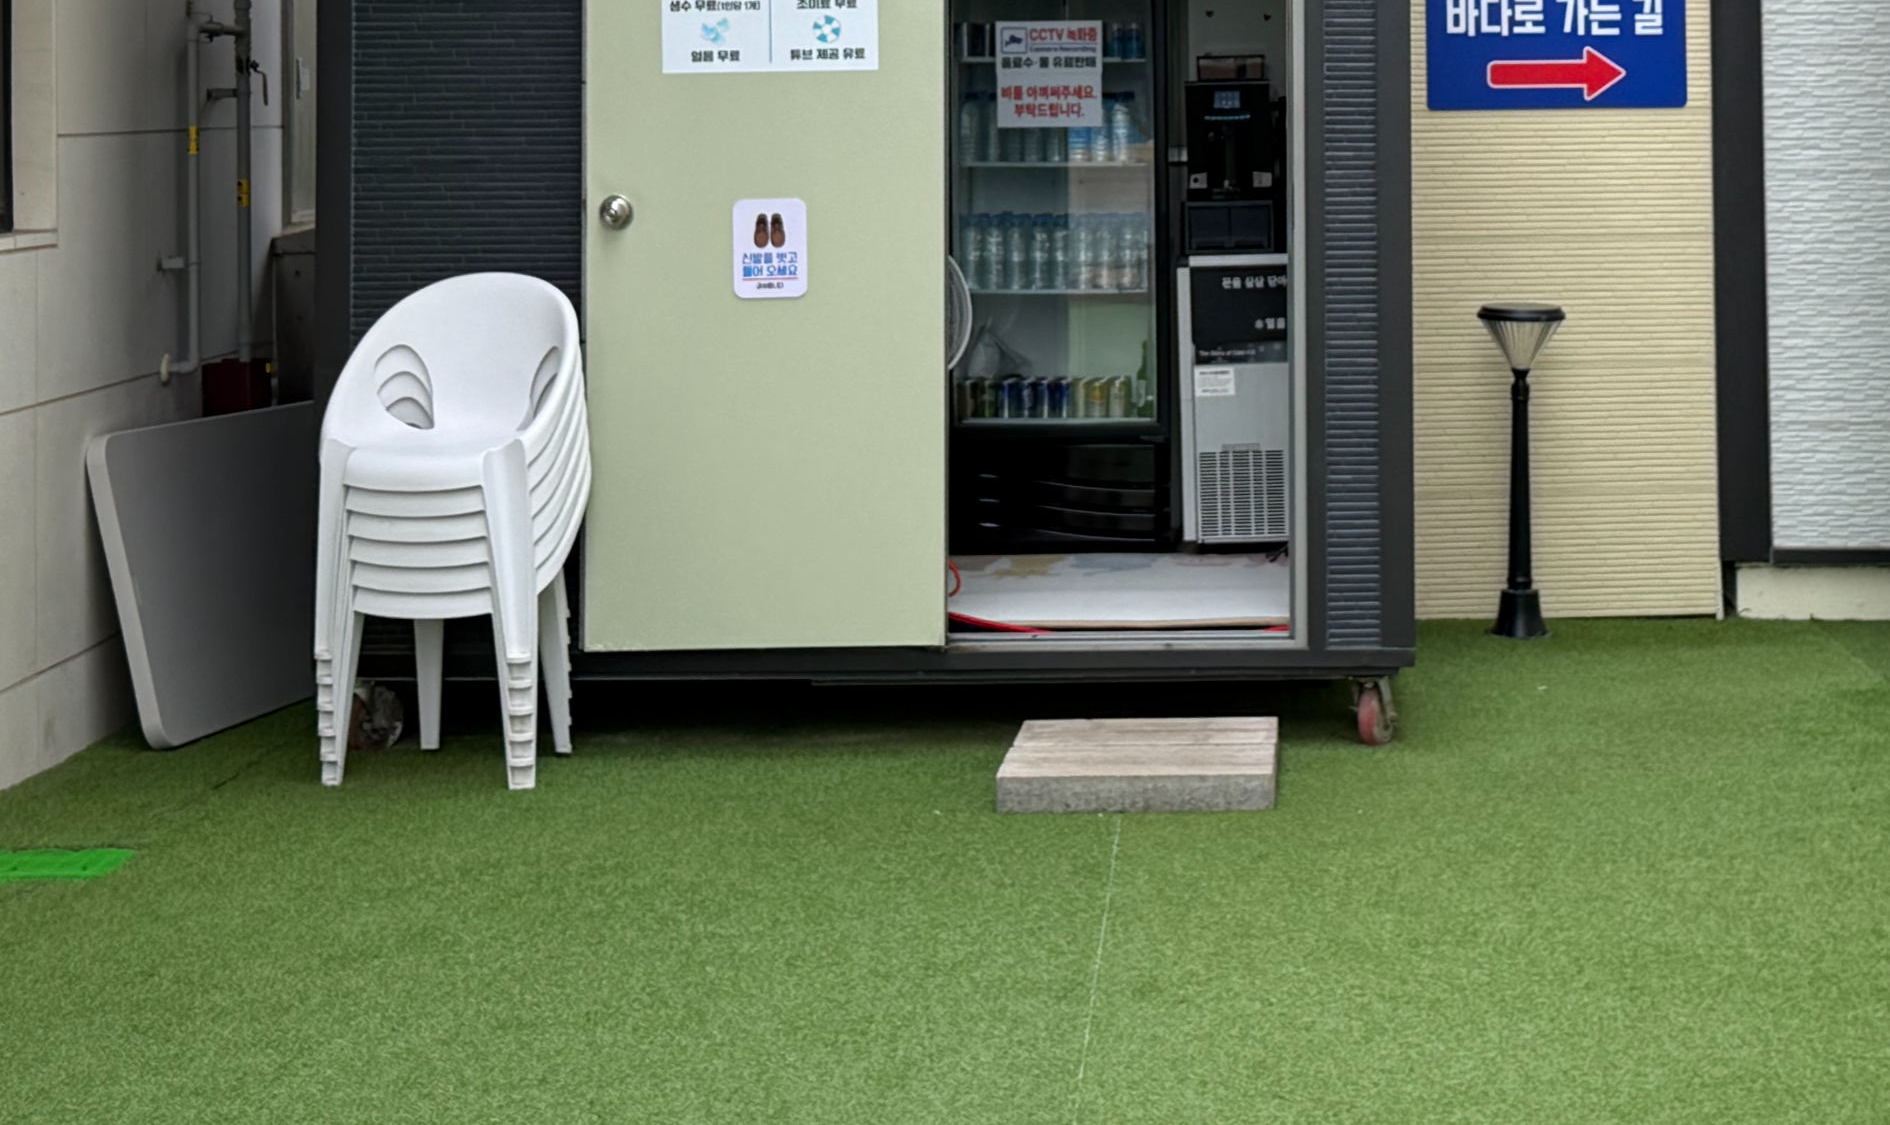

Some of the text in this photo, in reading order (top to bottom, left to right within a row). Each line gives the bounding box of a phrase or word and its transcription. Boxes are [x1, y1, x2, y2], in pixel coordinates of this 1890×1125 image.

[669, 0, 692, 12] 생수
[1029, 28, 1064, 42] CCTV
[691, 50, 740, 62] 얼음 무료
[790, 47, 865, 61] 튜브 제공 유료
[742, 251, 798, 265] 신발을 벗고
[742, 264, 798, 277] 들어 오세요
